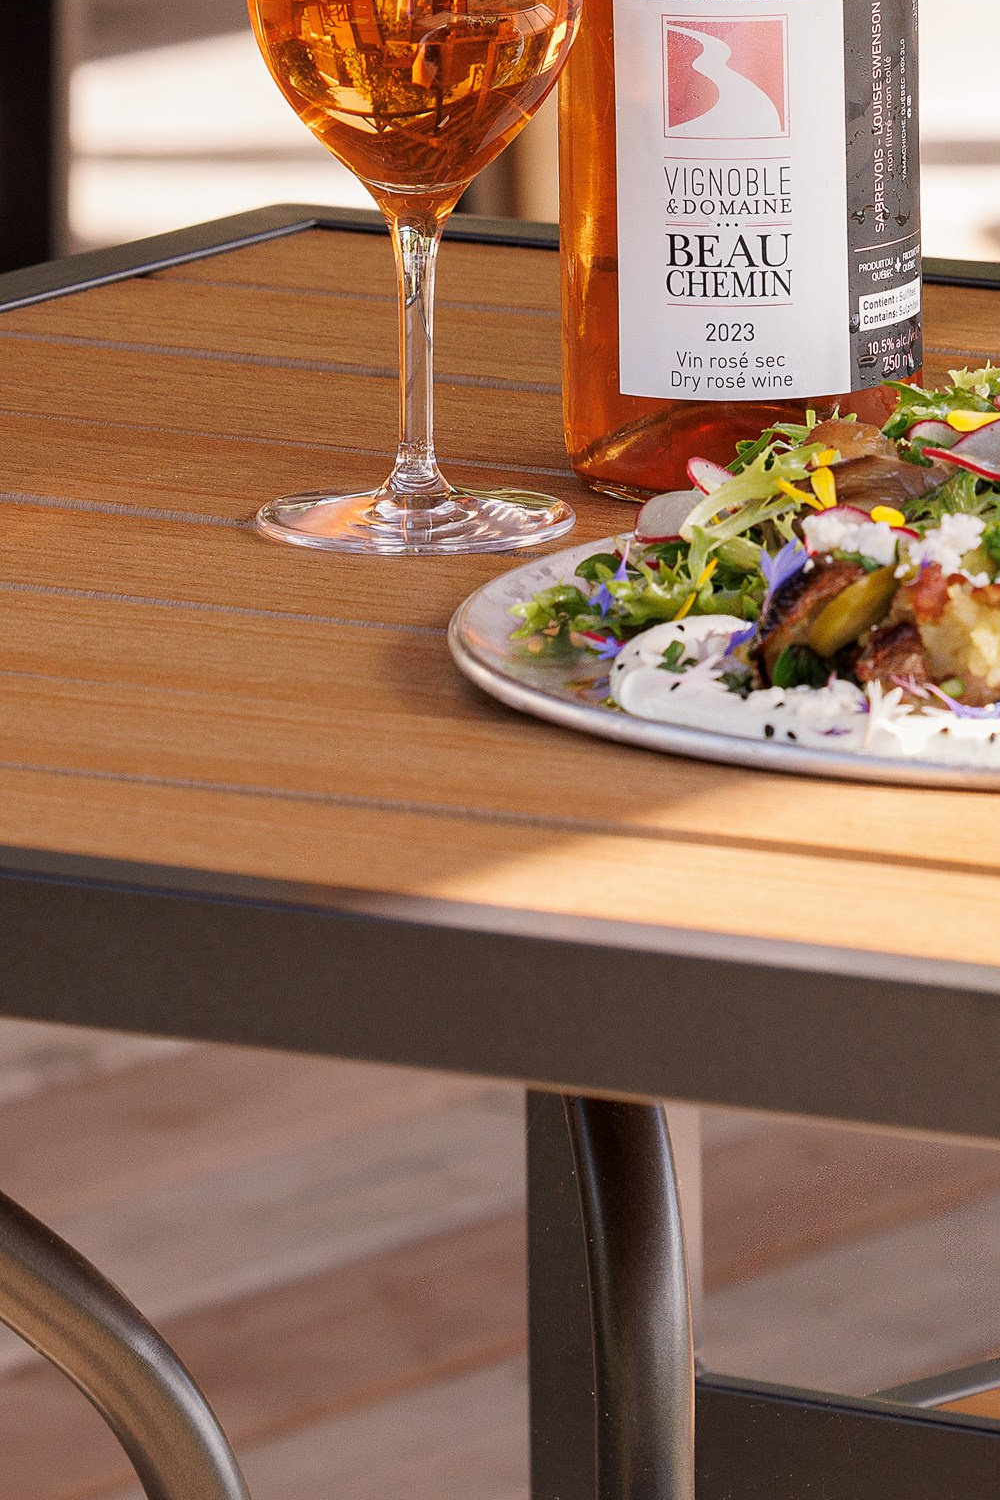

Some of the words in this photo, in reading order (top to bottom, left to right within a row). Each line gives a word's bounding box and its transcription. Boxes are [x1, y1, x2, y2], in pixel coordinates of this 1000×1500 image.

[871, 1, 882, 78] SWENSON
[873, 81, 883, 135] LOUISE
[664, 166, 791, 197] VIGNOBLE
[874, 148, 885, 232] SABREVOIS
[666, 198, 679, 215] &
[682, 198, 793, 216] DOMAINE
[665, 233, 793, 268] BEAU
[666, 269, 793, 298] CHEMIN
[705, 323, 755, 342] 2023
[867, 337, 894, 356] 10.5%
[676, 351, 703, 368] Vin
[709, 352, 749, 369] rosé
[755, 355, 786, 368] sec
[671, 370, 701, 392] Dry
[707, 372, 746, 388] rosé
[752, 371, 793, 388] wine
